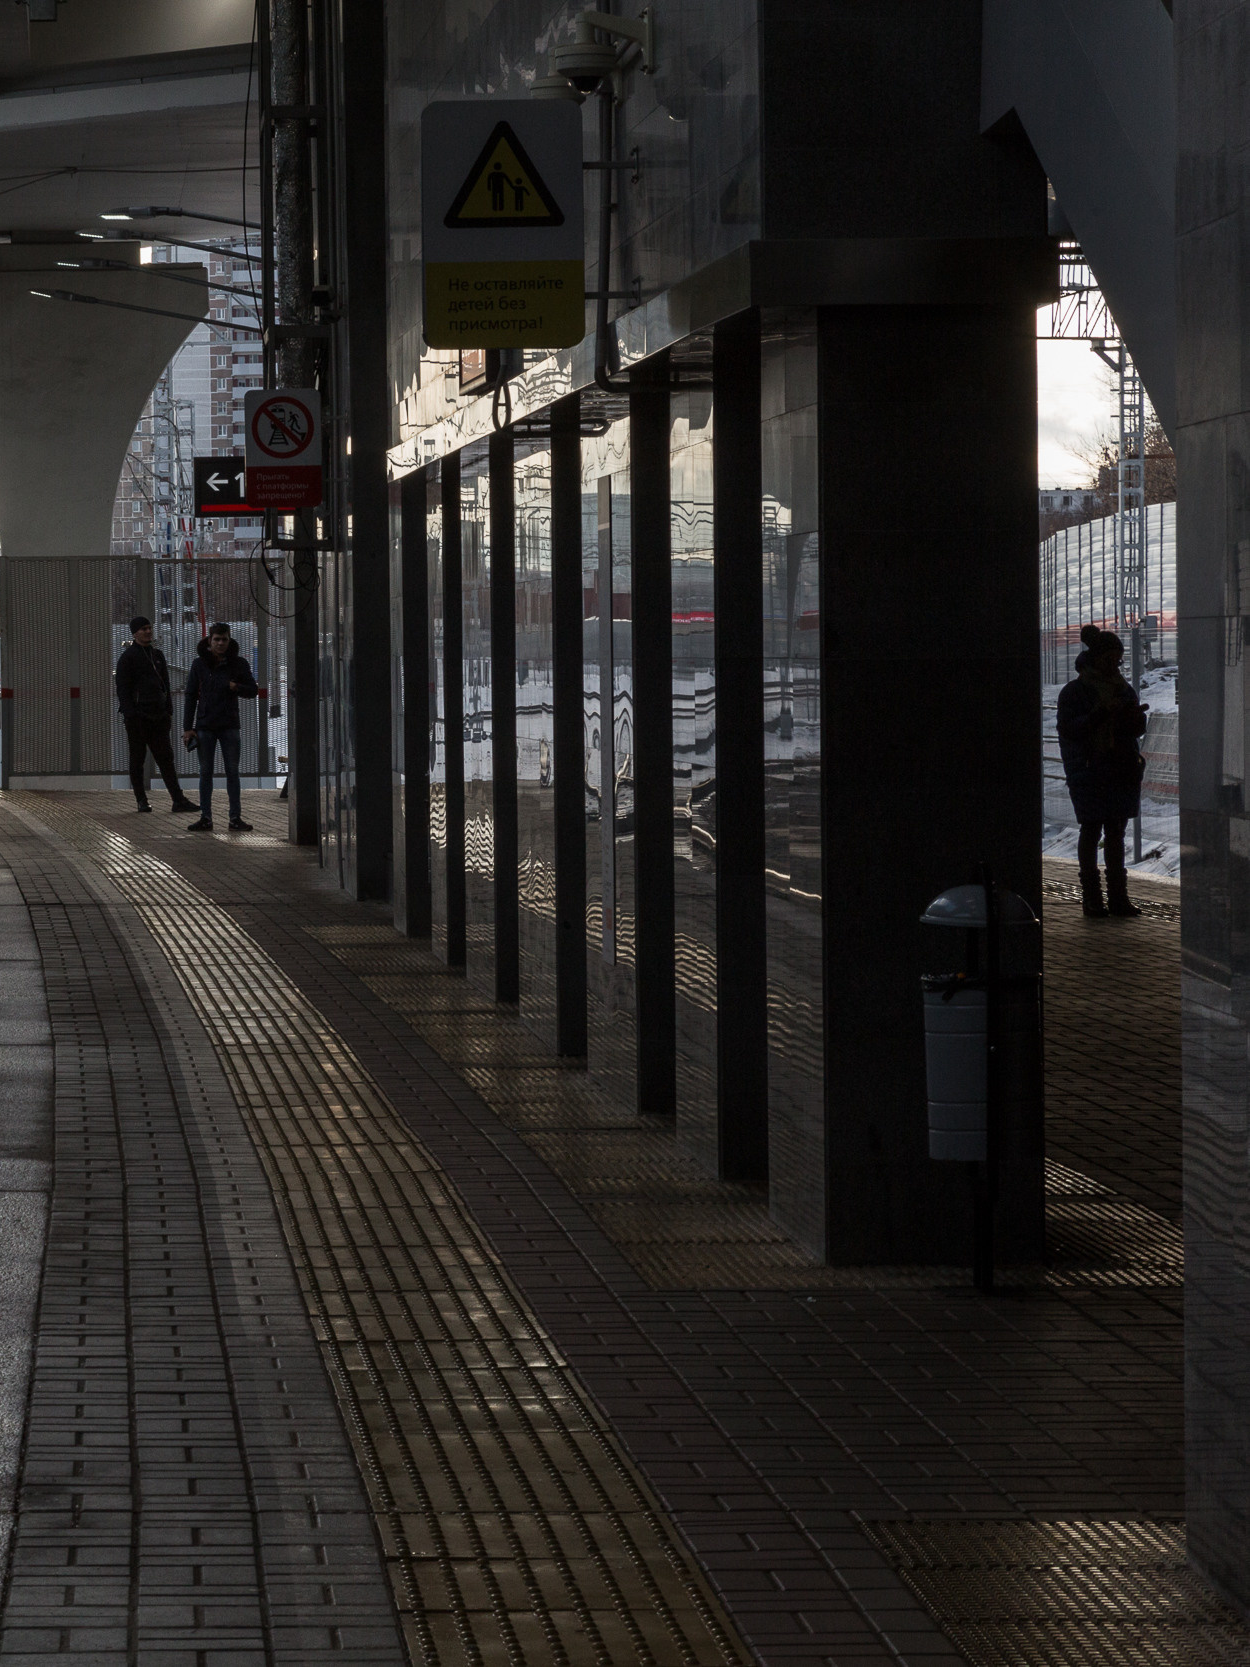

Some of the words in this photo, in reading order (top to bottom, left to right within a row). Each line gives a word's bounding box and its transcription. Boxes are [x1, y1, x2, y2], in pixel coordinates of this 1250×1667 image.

[448, 278, 470, 291] Не
[474, 275, 564, 291] оставляйте
[447, 296, 494, 313] детей
[498, 295, 527, 310] без
[448, 316, 543, 333] присмотра!
[234, 472, 245, 498] 1
[256, 473, 289, 482] Прыгать
[262, 482, 309, 492] платформы
